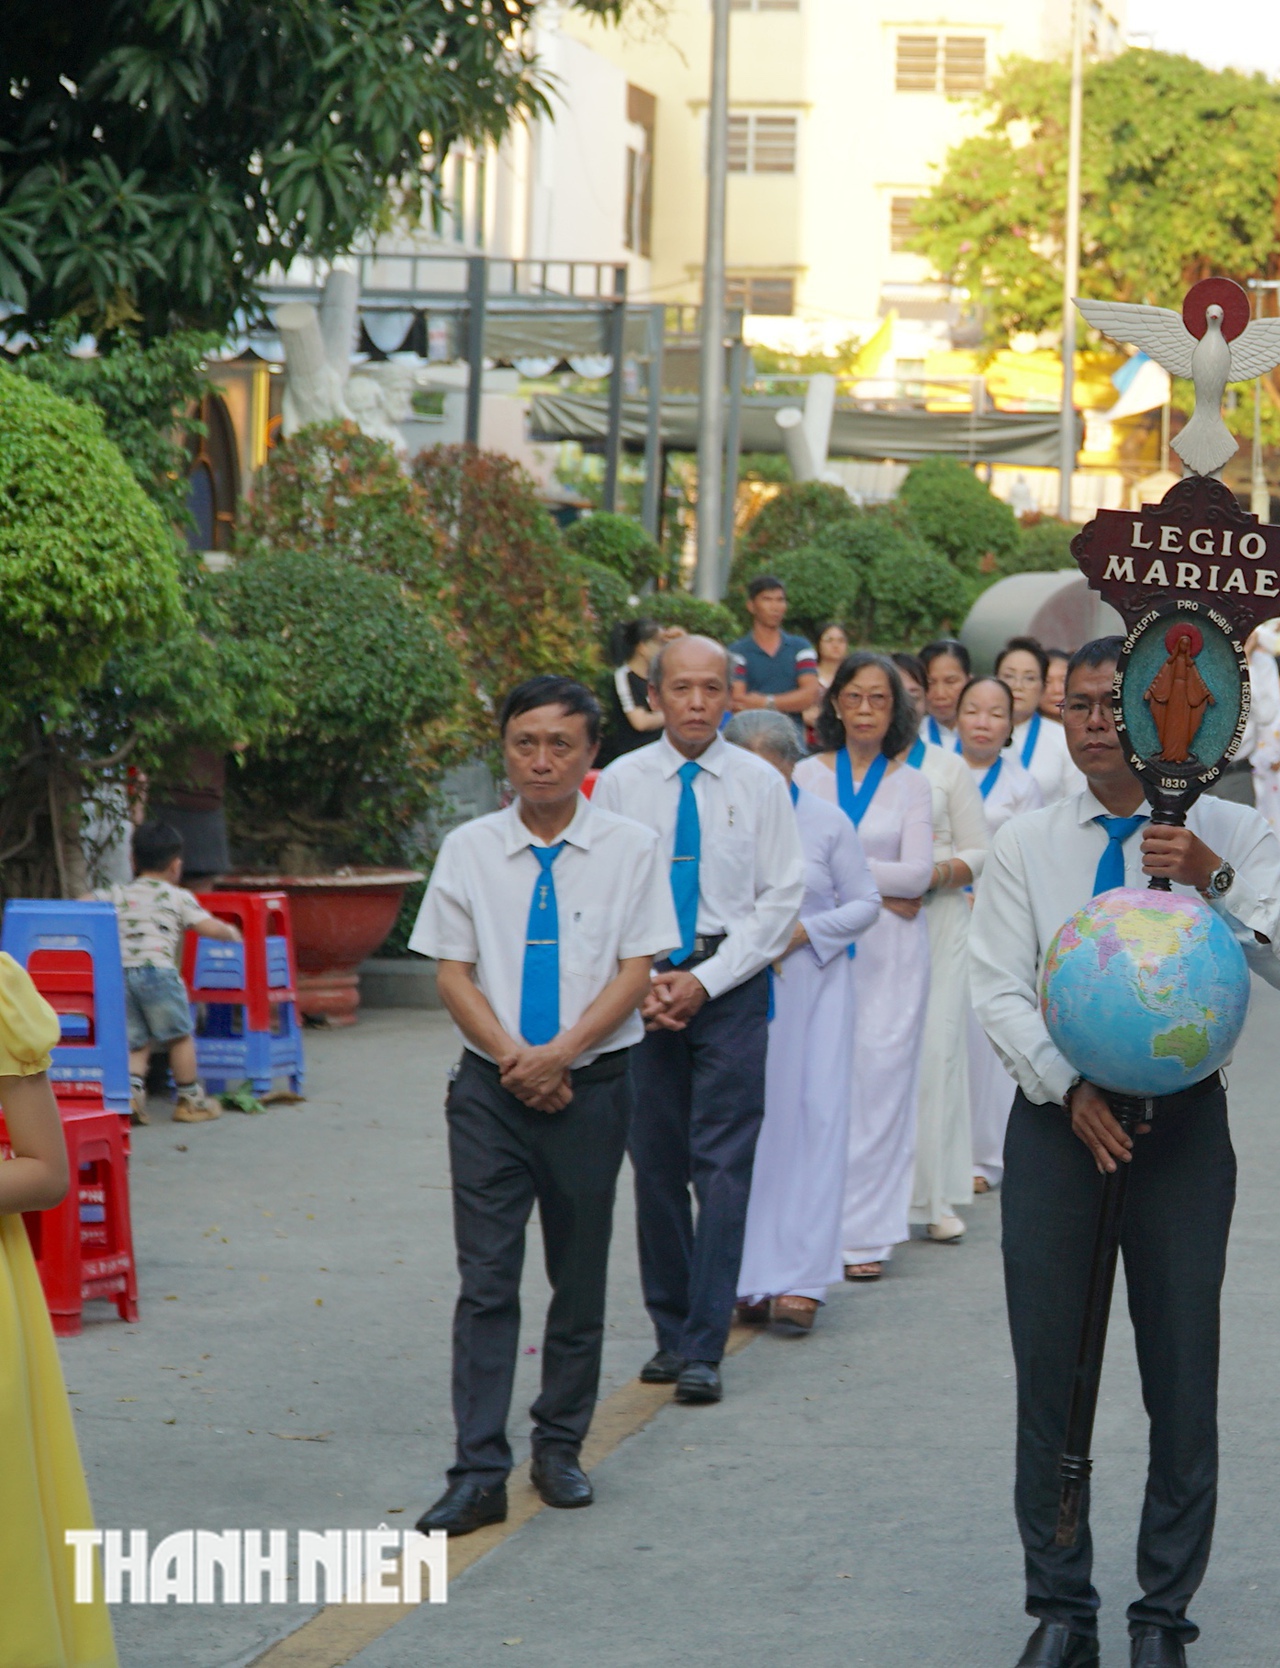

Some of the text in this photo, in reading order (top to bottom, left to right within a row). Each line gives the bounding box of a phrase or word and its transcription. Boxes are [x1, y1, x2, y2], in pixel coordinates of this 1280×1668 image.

[1130, 521, 1267, 560] LEGIO
[1102, 555, 1280, 598] MARIAE
[1177, 600, 1199, 611] PRO
[1207, 609, 1233, 635] NOBIS
[1232, 640, 1245, 653] AD
[1239, 657, 1249, 672] TE
[1112, 671, 1124, 699] LABE
[1161, 777, 1187, 789] 1830
[1198, 767, 1220, 784] ORA
